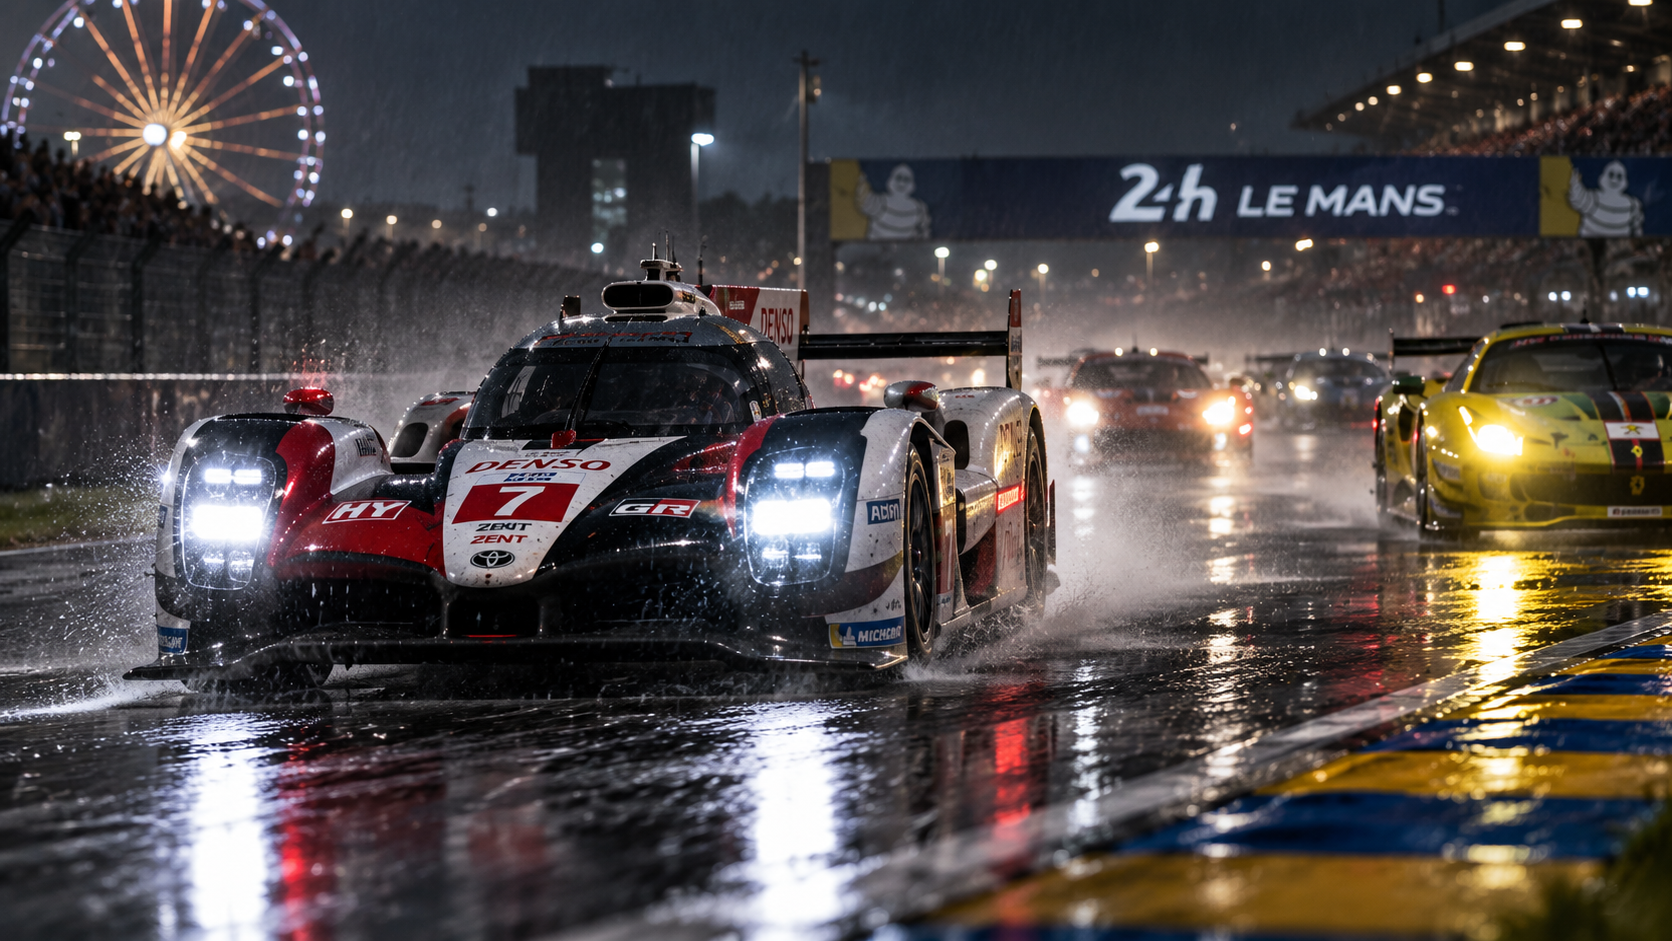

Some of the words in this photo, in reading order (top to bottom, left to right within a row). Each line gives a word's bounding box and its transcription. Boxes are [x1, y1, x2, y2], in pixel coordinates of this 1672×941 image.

[1236, 185, 1298, 217] LE
[1305, 185, 1446, 217] MANS
[761, 308, 794, 345] DENSO
[465, 458, 611, 474] DENSO
[494, 486, 546, 517] 7
[615, 503, 691, 515] GR
[331, 502, 406, 519] HY
[470, 534, 528, 544] ZENT
